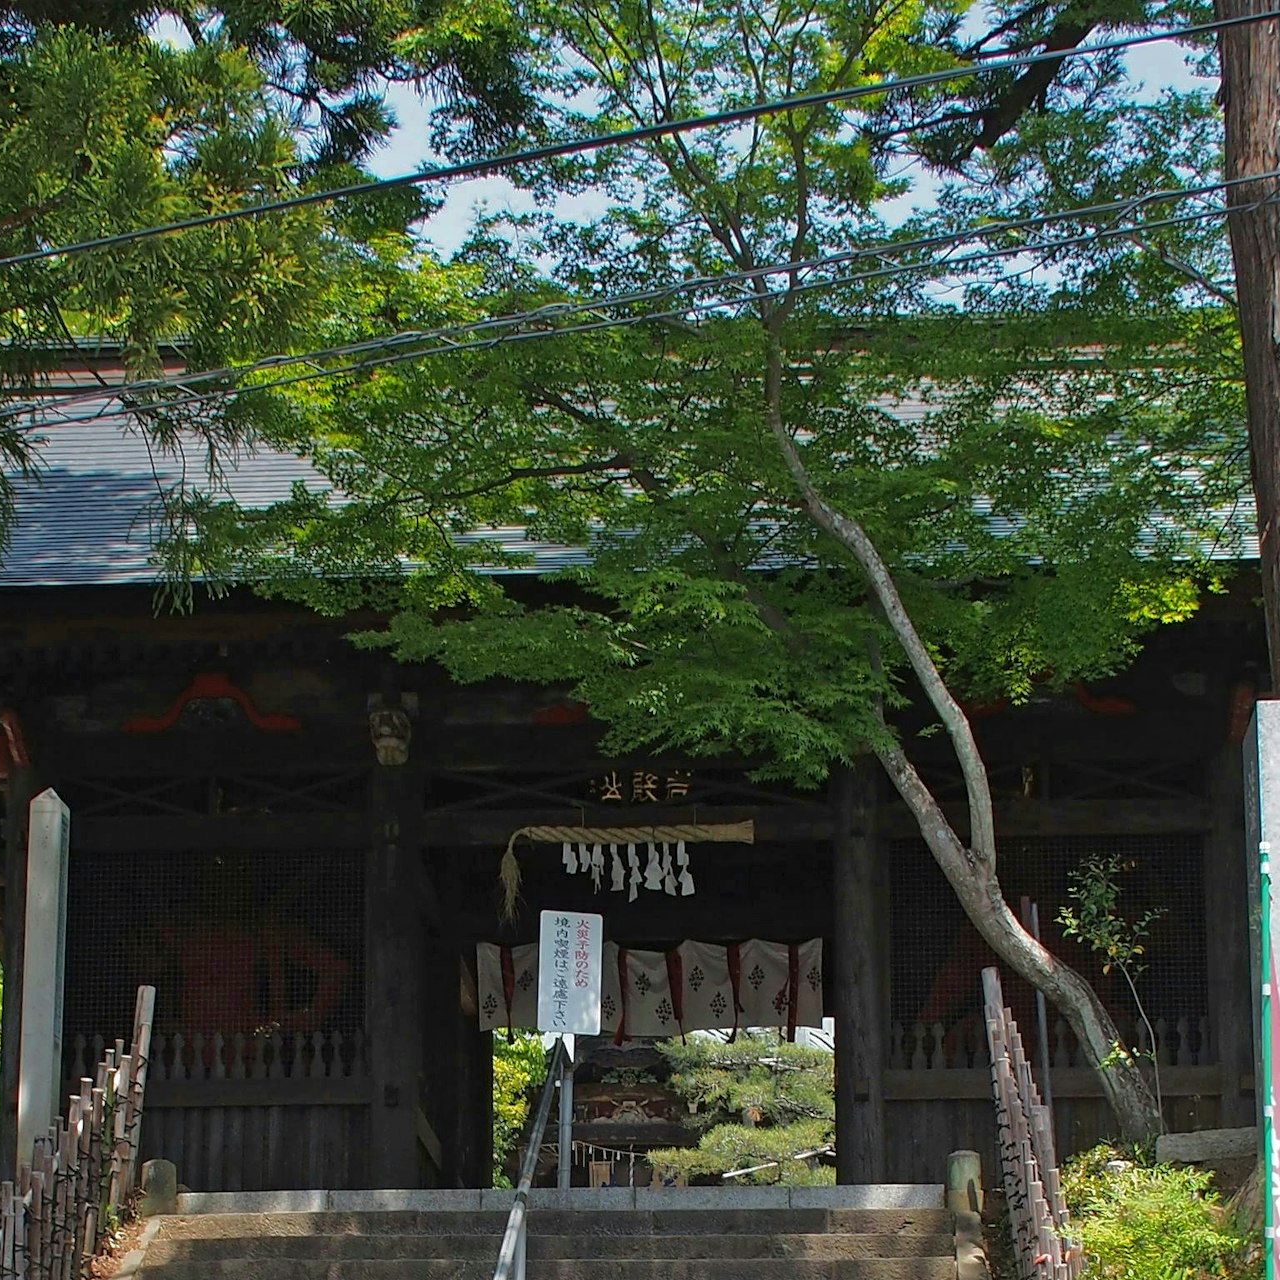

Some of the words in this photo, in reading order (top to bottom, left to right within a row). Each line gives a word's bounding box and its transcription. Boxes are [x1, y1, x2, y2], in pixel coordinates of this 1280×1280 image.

[552, 916, 571, 1027] 境内喫煙はご遠慮下さい
[575, 919, 590, 988] 火災予防のため
